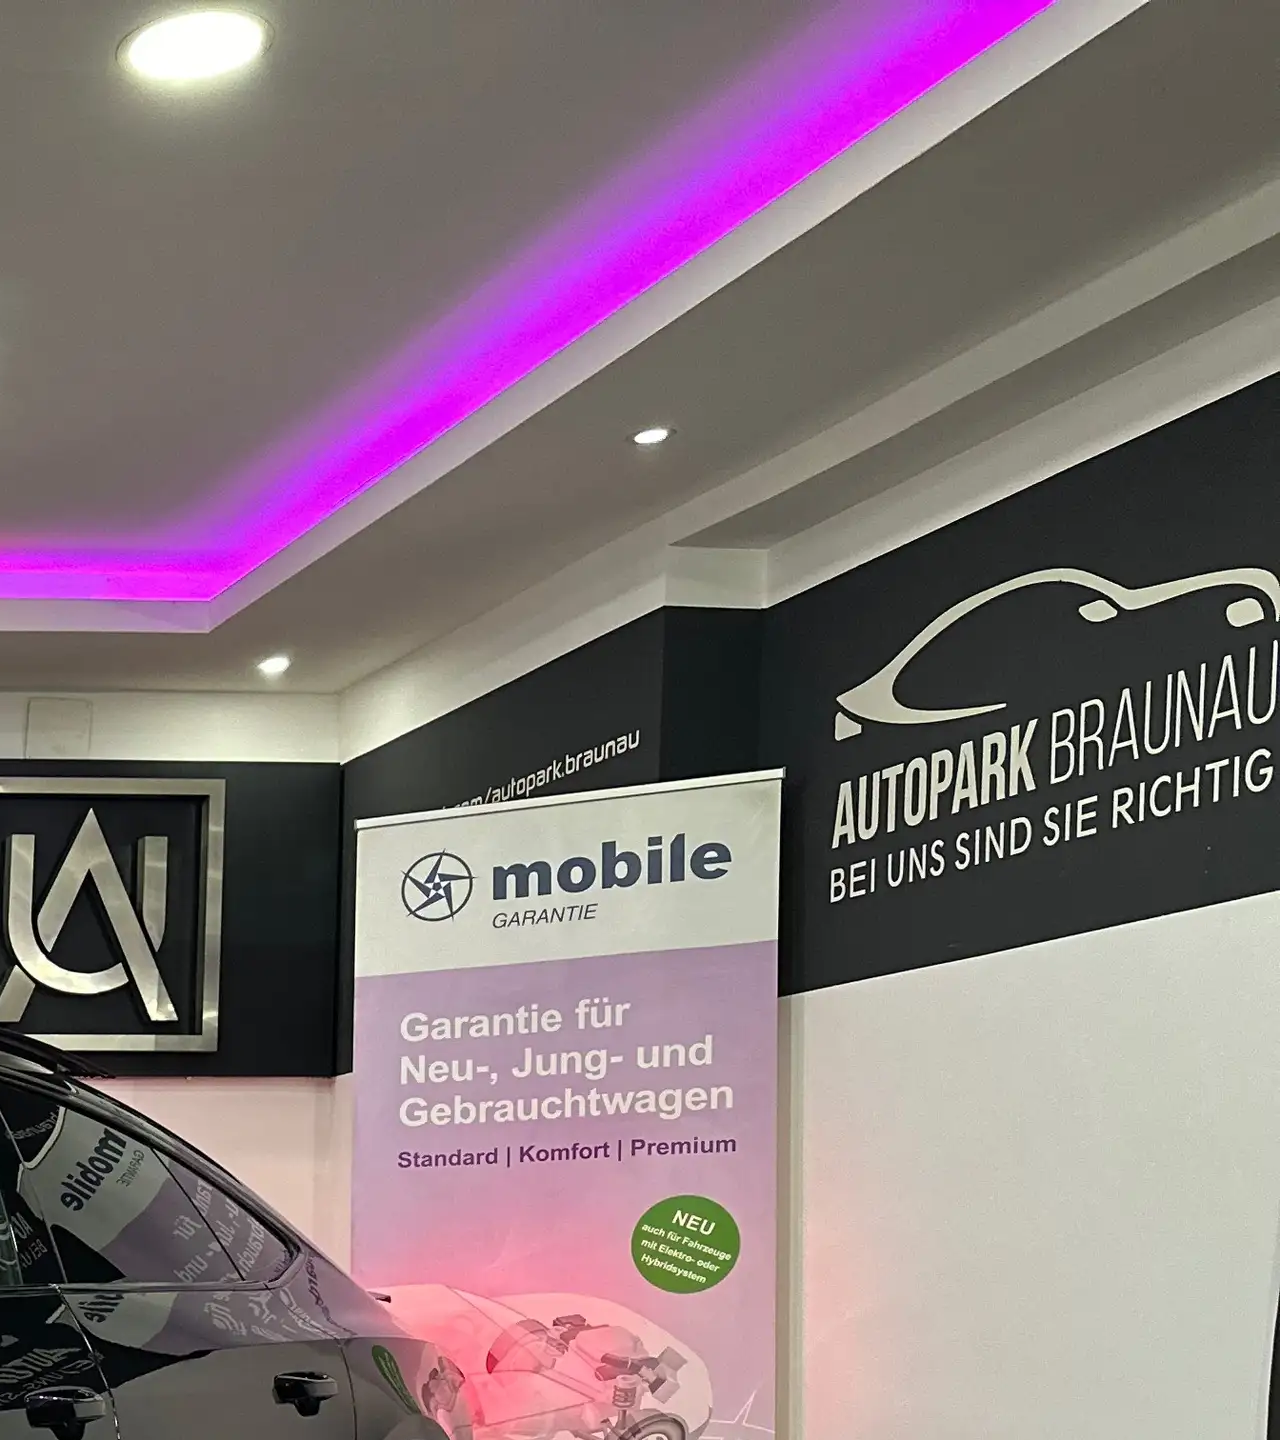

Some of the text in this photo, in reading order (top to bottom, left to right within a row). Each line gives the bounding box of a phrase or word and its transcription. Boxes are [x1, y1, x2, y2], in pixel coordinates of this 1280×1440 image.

[832, 639, 1280, 849] AUTOPARK BRAUNAU
[829, 748, 1274, 903] BEI UNS SIND SIE RICHTIG
[492, 832, 733, 901] mobile
[491, 903, 599, 929] GARANTIE
[399, 996, 632, 1043] Garantie für
[399, 1034, 713, 1086] Neu-, Jung- und
[398, 1084, 734, 1128] Gebrauchtwagen
[397, 1146, 499, 1169] Standard
[518, 1140, 611, 1164] Komfort
[630, 1136, 737, 1158] Premium
[641, 1223, 732, 1261] auch für Fahrzeuge
[671, 1209, 715, 1235] NEU
[640, 1238, 657, 1250] mit
[696, 1258, 720, 1272] oder
[640, 1252, 707, 1283] Hybridsystem
